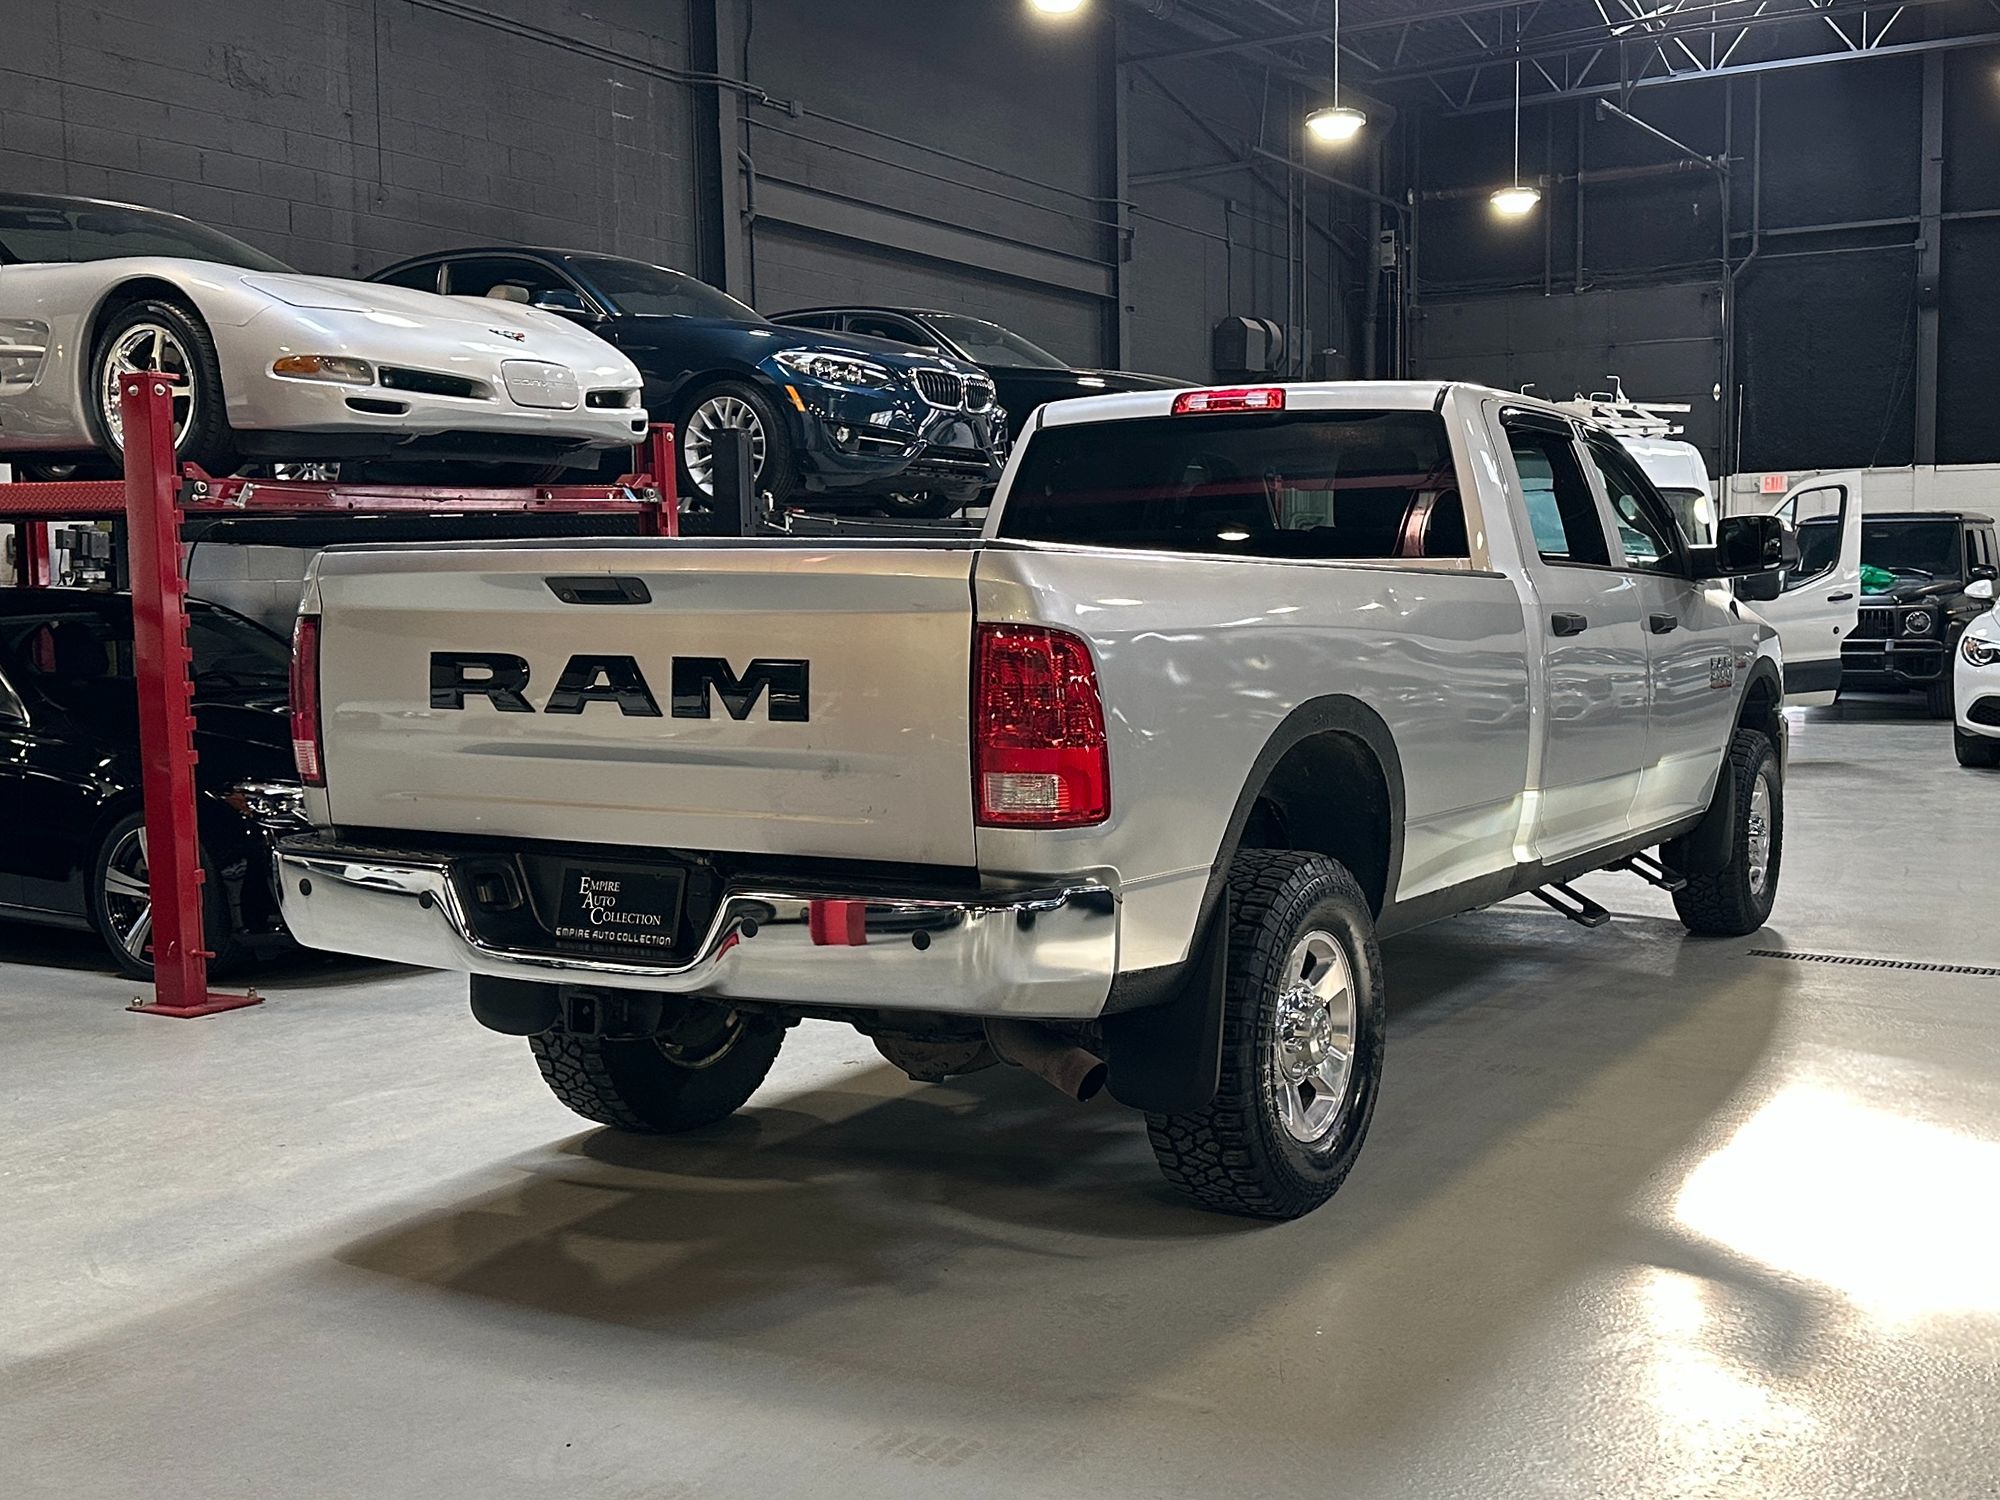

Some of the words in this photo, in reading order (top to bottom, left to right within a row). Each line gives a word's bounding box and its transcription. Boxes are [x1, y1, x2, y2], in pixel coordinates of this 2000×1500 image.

[430, 651, 810, 722] RAM
[579, 876, 621, 894] EMPIRE
[581, 892, 616, 909] AUTO
[590, 907, 661, 926] COLLECTION
[555, 927, 590, 938] EMPIRE
[592, 930, 615, 941] AUTO
[617, 932, 671, 946] COLLECTION
